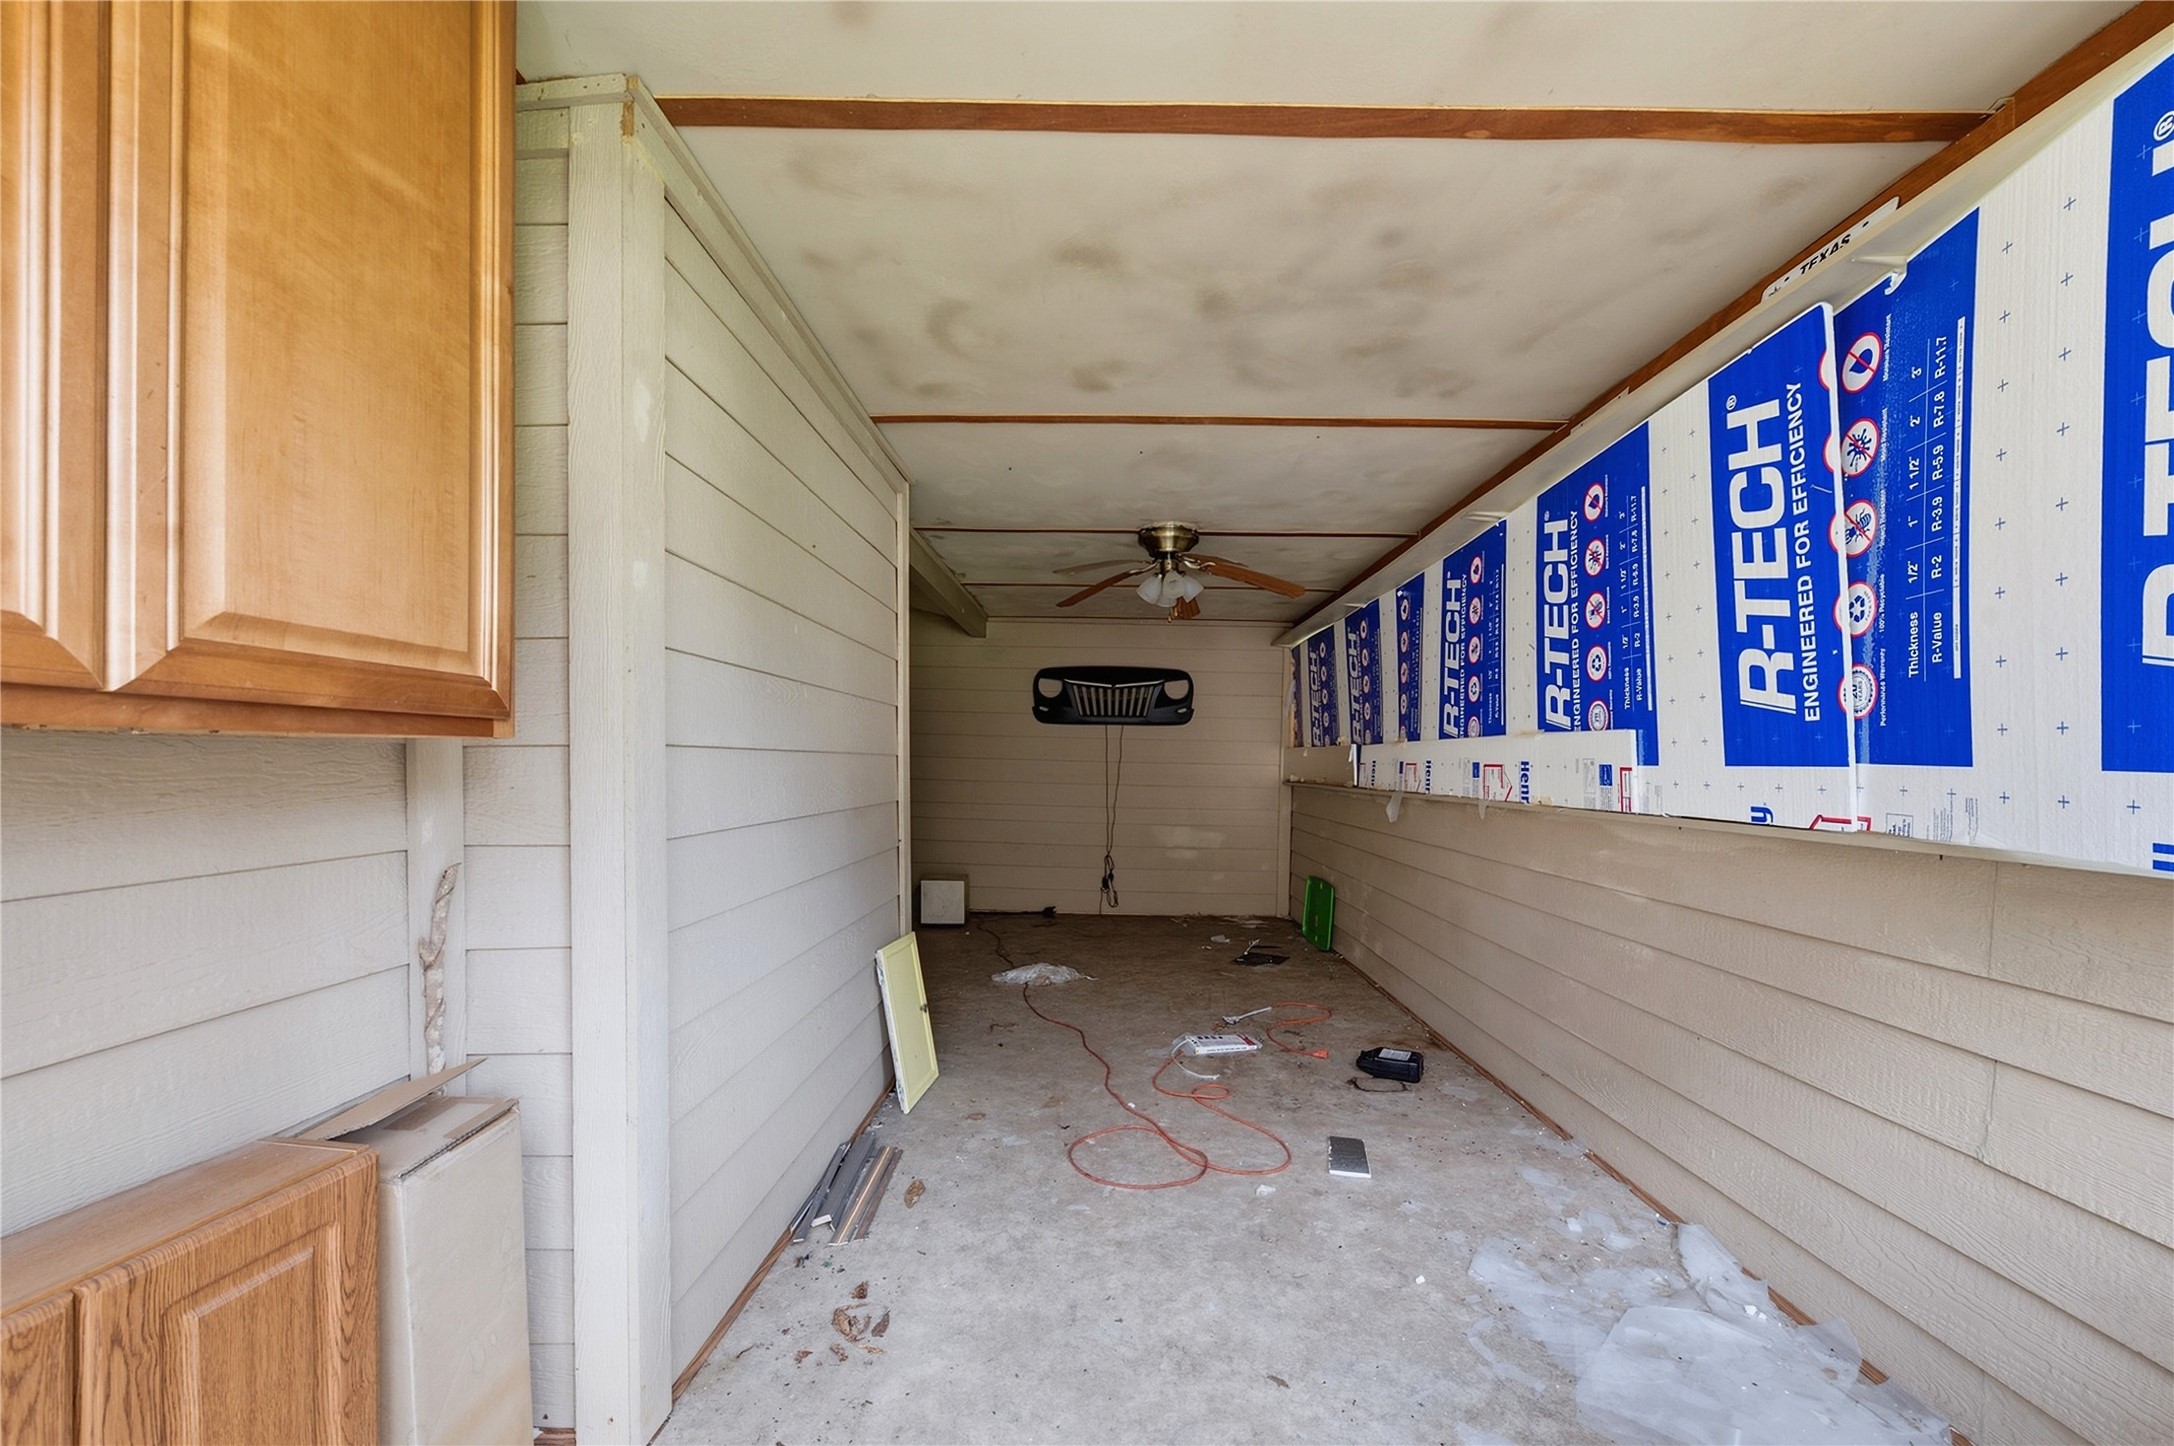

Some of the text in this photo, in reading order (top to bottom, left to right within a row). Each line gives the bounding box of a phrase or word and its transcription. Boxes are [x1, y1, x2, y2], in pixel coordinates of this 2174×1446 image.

[1800, 234, 1851, 274] TEXAS
[1931, 336, 1947, 663] R-Value R-2 R-3.9 R-5.9 R-7.8 R-11.7
[1570, 510, 1579, 599] EFFICIENCY
[1786, 382, 1821, 722] ENGINEERED FOR EFFICIENCY
[1571, 602, 1579, 634] FOR
[1908, 611, 1919, 678] Thickness
